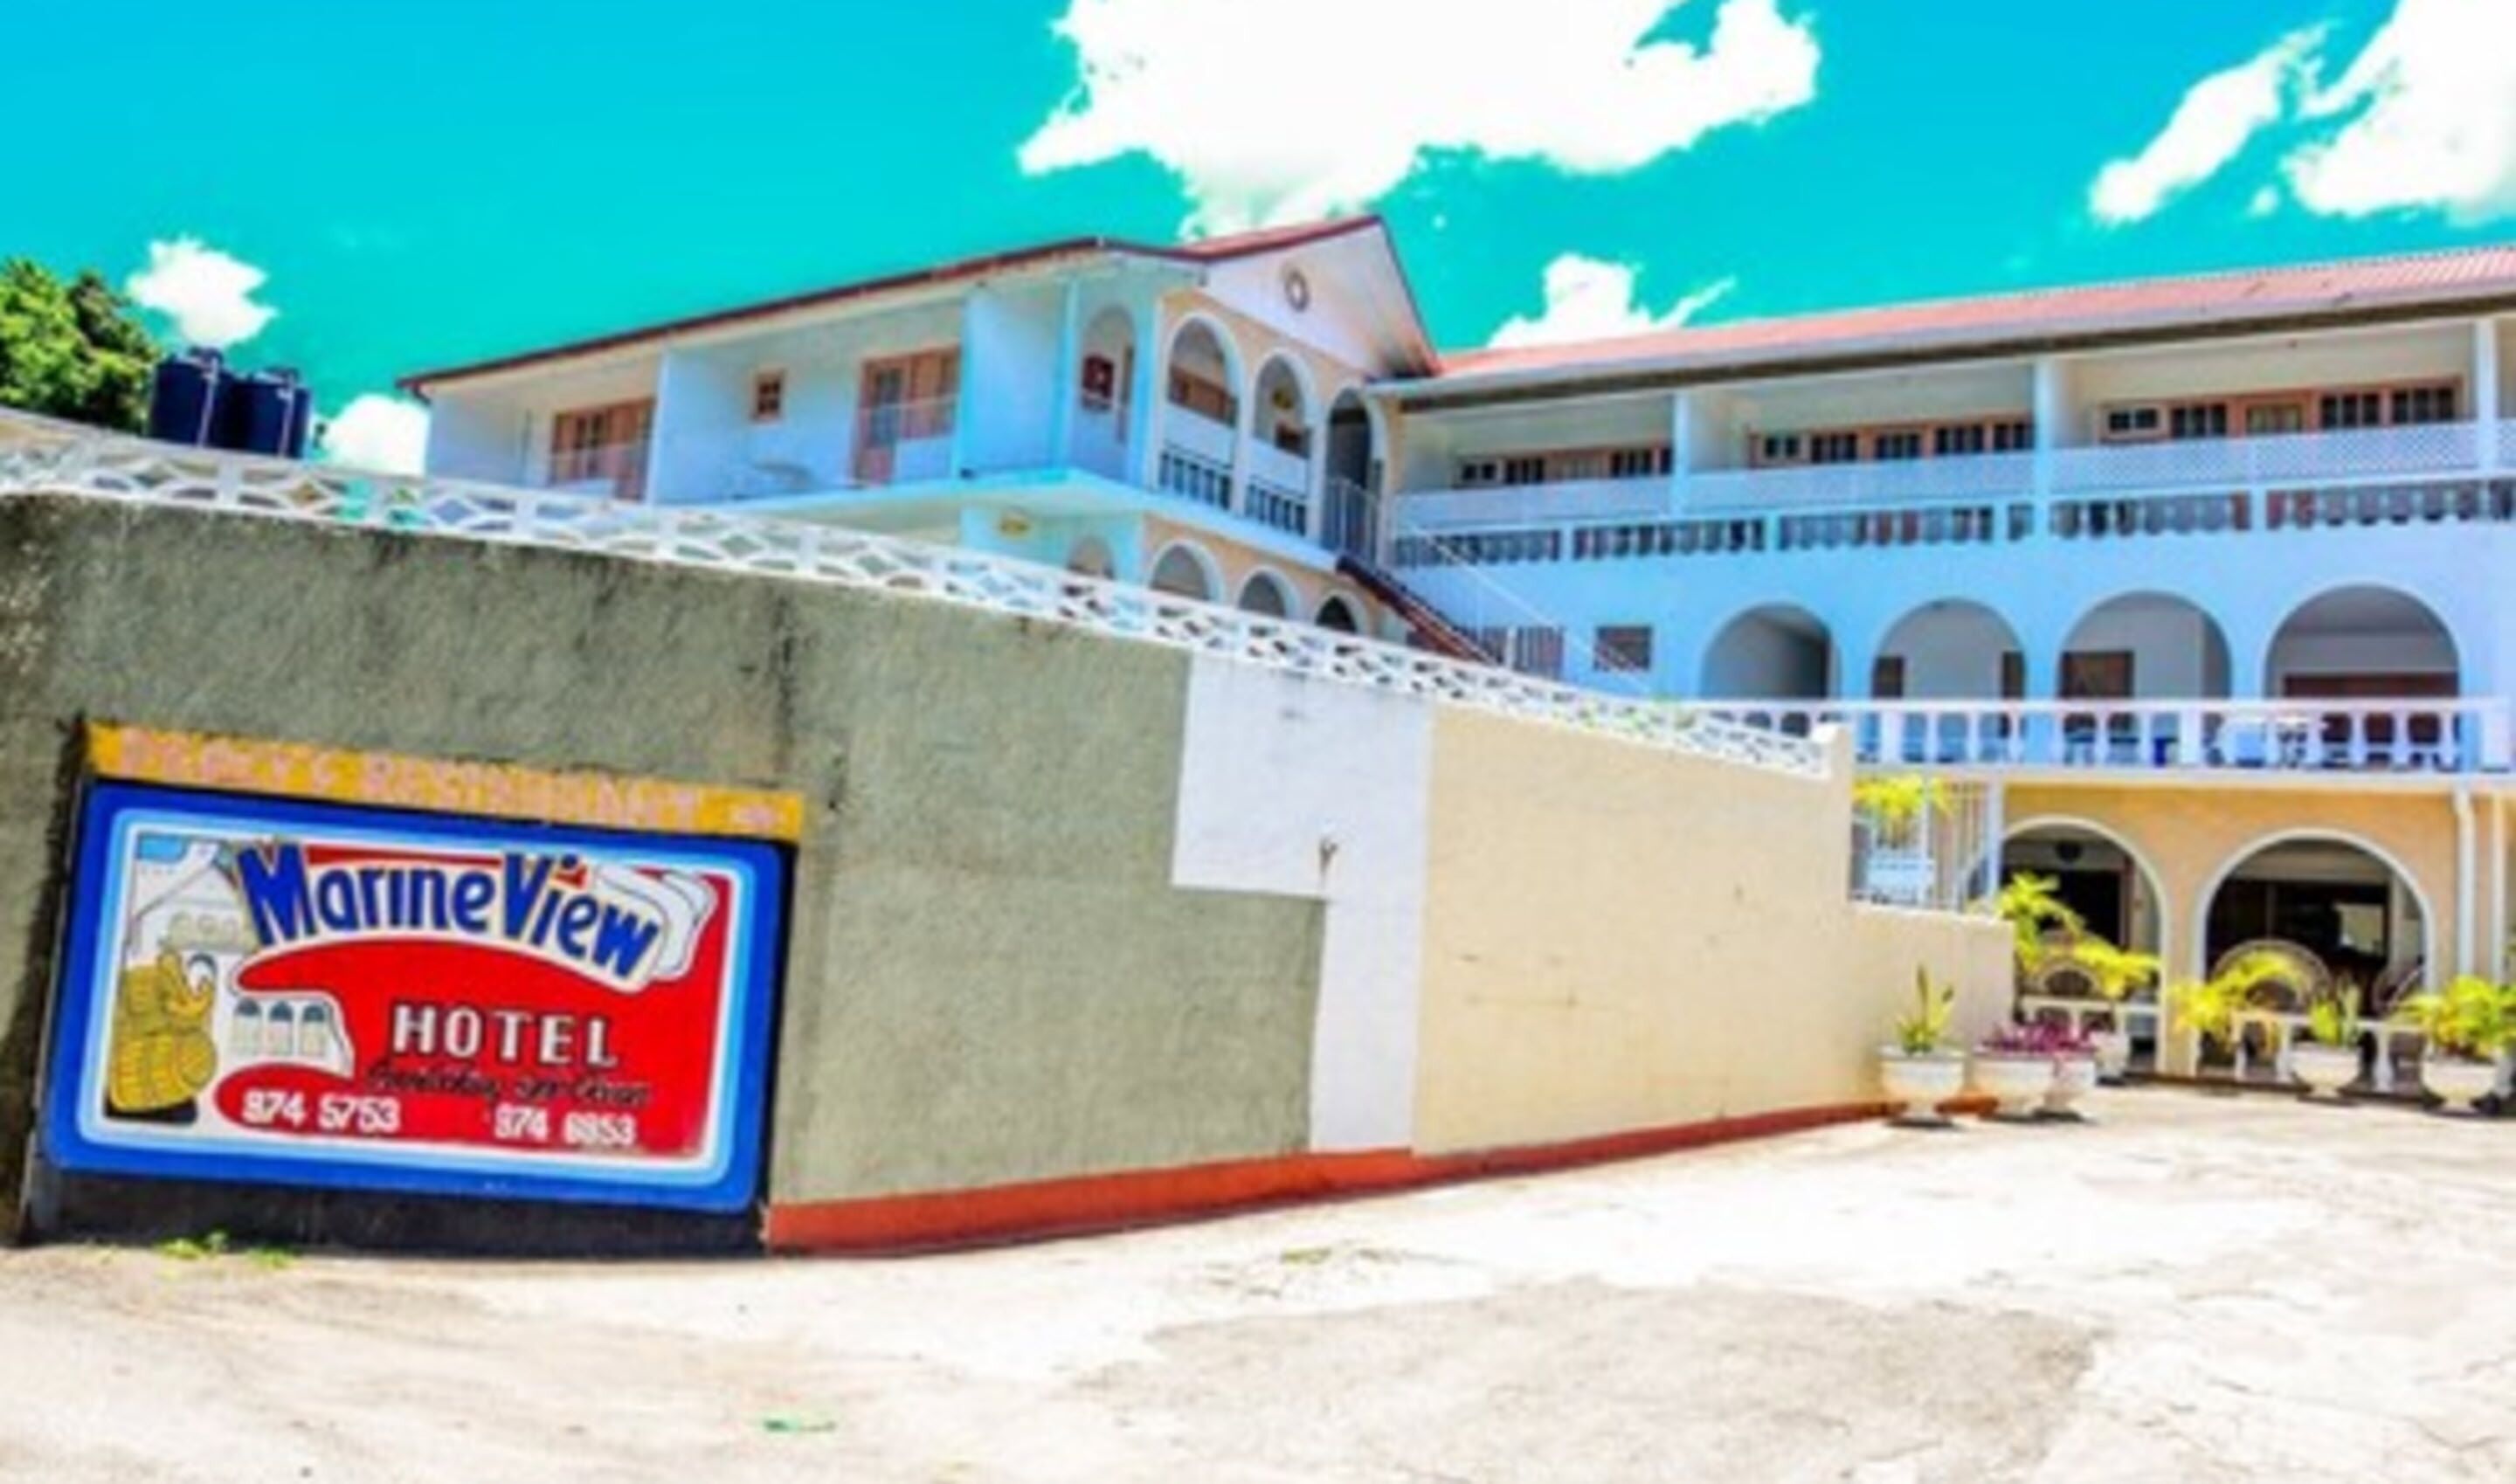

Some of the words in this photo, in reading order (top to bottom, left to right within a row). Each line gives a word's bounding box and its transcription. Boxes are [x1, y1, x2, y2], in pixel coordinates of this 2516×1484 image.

[390, 1002, 620, 1070] HOTEL
[241, 1087, 306, 1129] 974
[317, 1091, 403, 1135] 5753
[494, 1101, 550, 1142] 974
